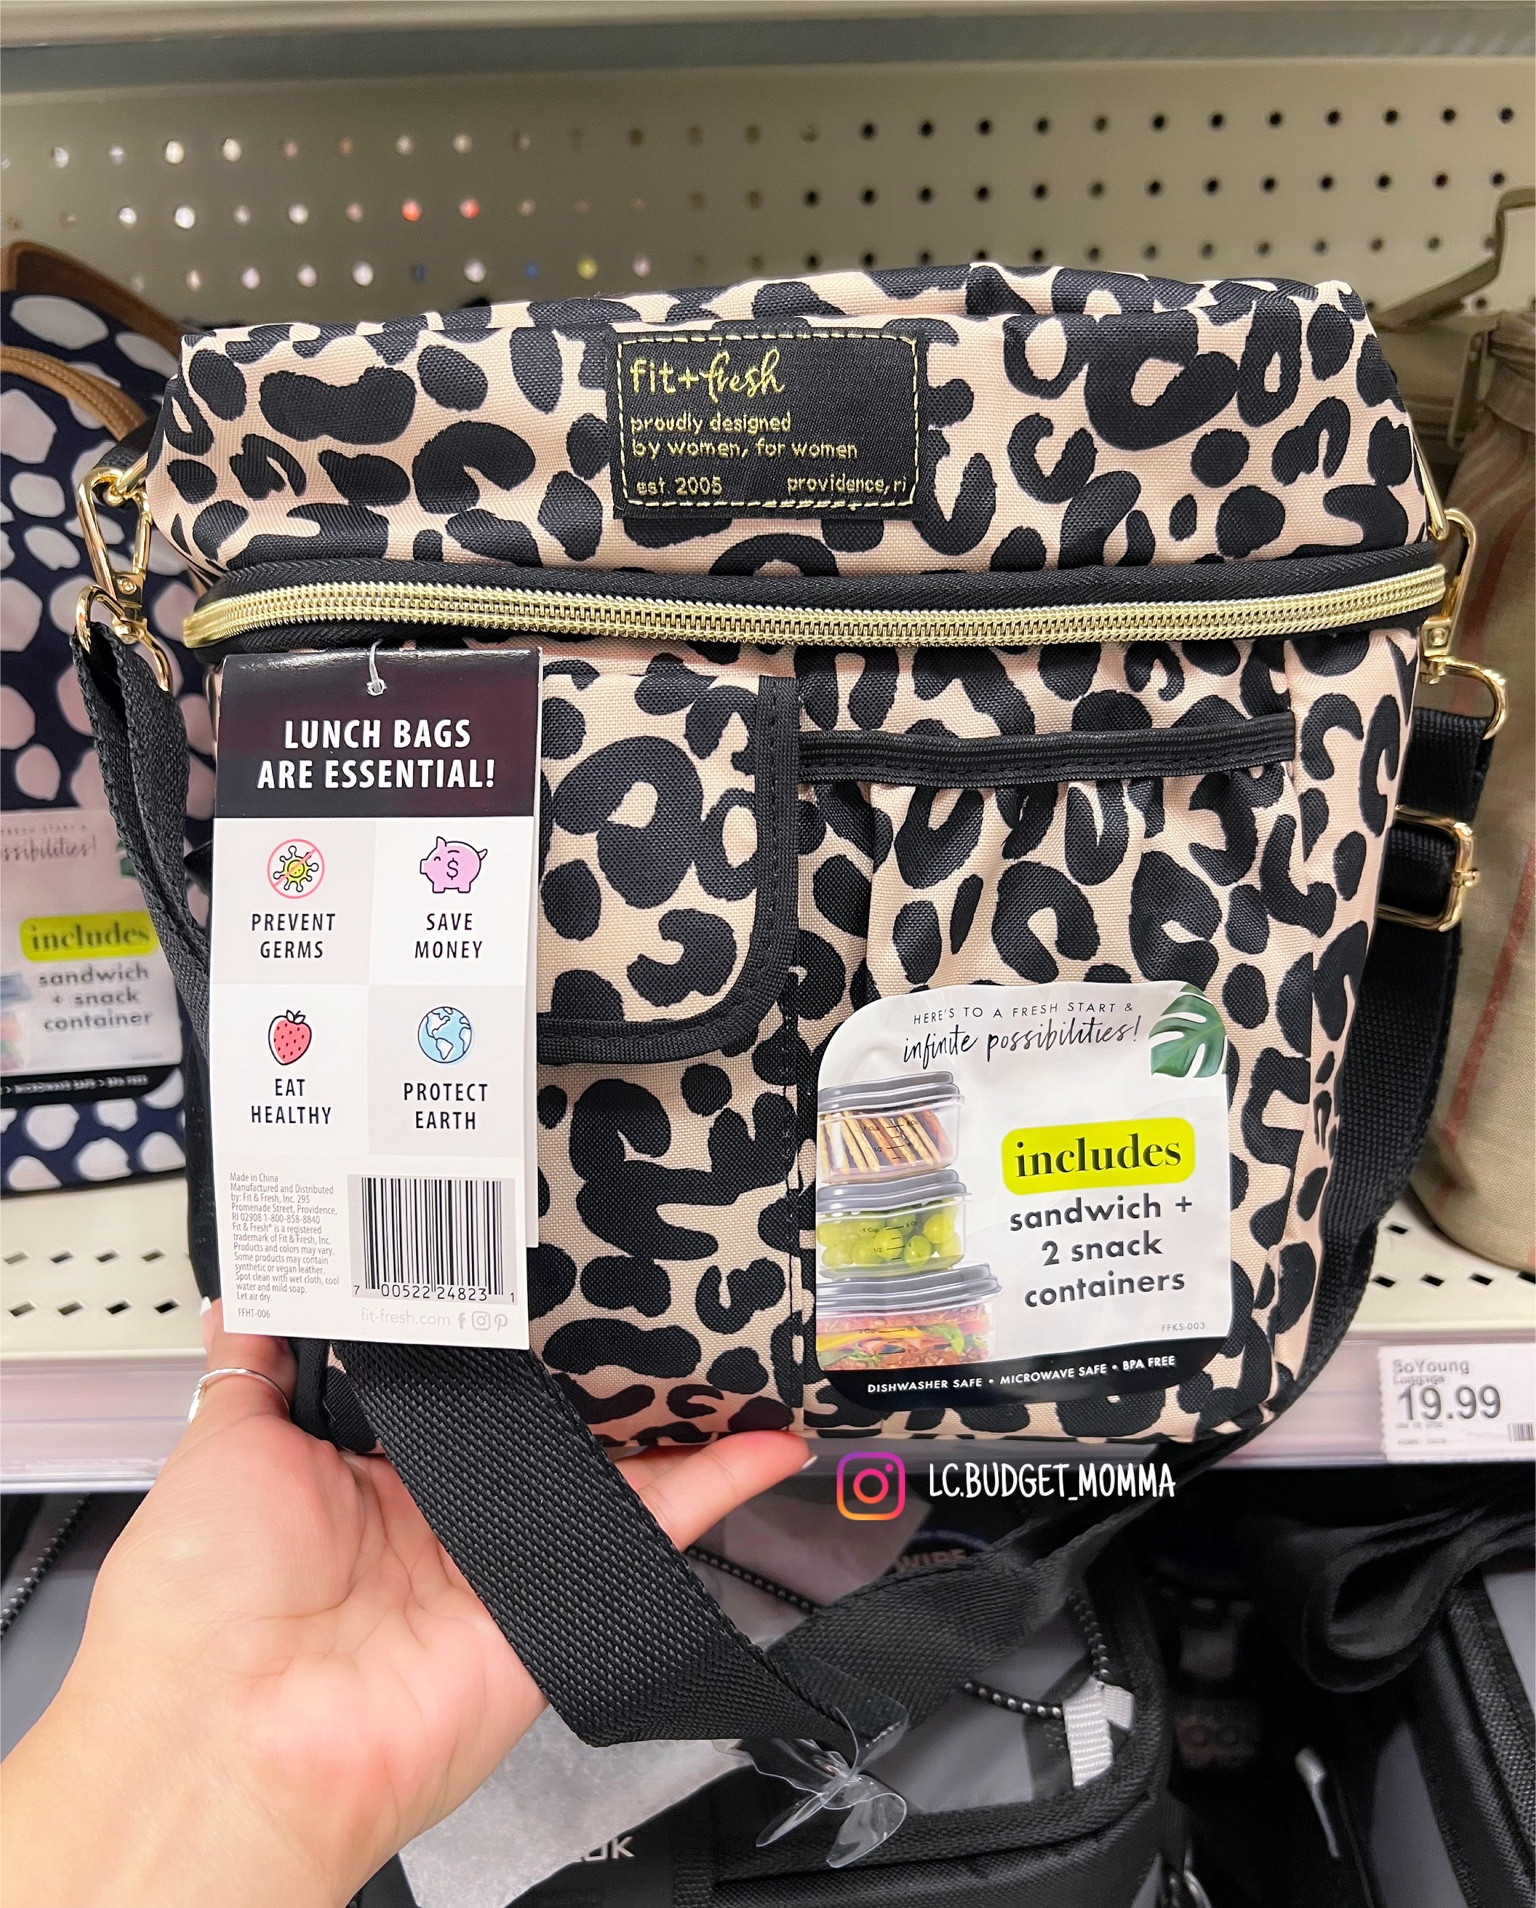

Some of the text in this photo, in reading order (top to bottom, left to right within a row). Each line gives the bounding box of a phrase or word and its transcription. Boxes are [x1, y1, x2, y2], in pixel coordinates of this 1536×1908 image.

[630, 411, 792, 435] proudly designed
[632, 437, 858, 460] by women, for women
[675, 476, 723, 496] 2005
[284, 719, 472, 749] LUNCH BAGS
[257, 758, 496, 789] ARE ESSENTIAL!
[251, 913, 336, 931] PREVENT
[426, 913, 473, 931] SAVE
[32, 921, 149, 952] includes
[260, 940, 324, 959] GERMS
[414, 940, 483, 959] MONEY
[39, 961, 149, 987] sandwich
[74, 986, 140, 1007] snack
[44, 1009, 153, 1032] container
[913, 1002, 1133, 1025] HERE'S TO A FRESH START &
[903, 1015, 1142, 1070] infinite possibilities!
[274, 1078, 306, 1097] EAT
[403, 1083, 489, 1102] PROTECT
[250, 1105, 332, 1125] HEALTHY
[415, 1111, 476, 1130] EARTH
[1016, 1133, 1182, 1178] includes
[230, 1172, 278, 1182] Made in China
[231, 1183, 334, 1194] Manufactured and Distributed
[243, 1193, 252, 1202] Fit
[253, 1194, 259, 1202] &
[261, 1193, 281, 1203] Fresh,
[283, 1194, 295, 1203] Inc.
[297, 1195, 310, 1204] 295
[232, 1202, 338, 1215] Promenade Street, Providence,
[241, 1213, 262, 1222] 02908
[1009, 1195, 1193, 1232] sandwich +
[232, 1223, 241, 1231] Fit
[274, 1224, 280, 1232] is
[287, 1225, 322, 1235] registered
[233, 1233, 331, 1245] trademark of Fit & Fresh, Inc.
[1041, 1230, 1163, 1267] 2 snack
[234, 1242, 335, 1256] Products and colors may vary.
[234, 1252, 329, 1265] Some products may contain
[235, 1263, 266, 1273] synthetic
[276, 1266, 297, 1275] vegan
[299, 1265, 325, 1275] leather.
[236, 1271, 340, 1285] Spot clean with wet cloth, cool
[236, 1283, 307, 1294] water and mild soap.
[237, 1291, 248, 1300] Let
[249, 1292, 258, 1301] air
[354, 1284, 515, 1303] 7 00522 24823 1
[1024, 1271, 1185, 1308] containers
[238, 1308, 271, 1318] FFHT-006
[361, 1307, 450, 1326] fit-fresh.com
[1122, 1355, 1176, 1371] BPA FREE
[1392, 1359, 1470, 1374] SoYoung
[999, 1364, 1107, 1385] MICROWAVE SAFE
[867, 1377, 982, 1393] DISHWASHER SAFE
[1399, 1384, 1501, 1420] 19.99
